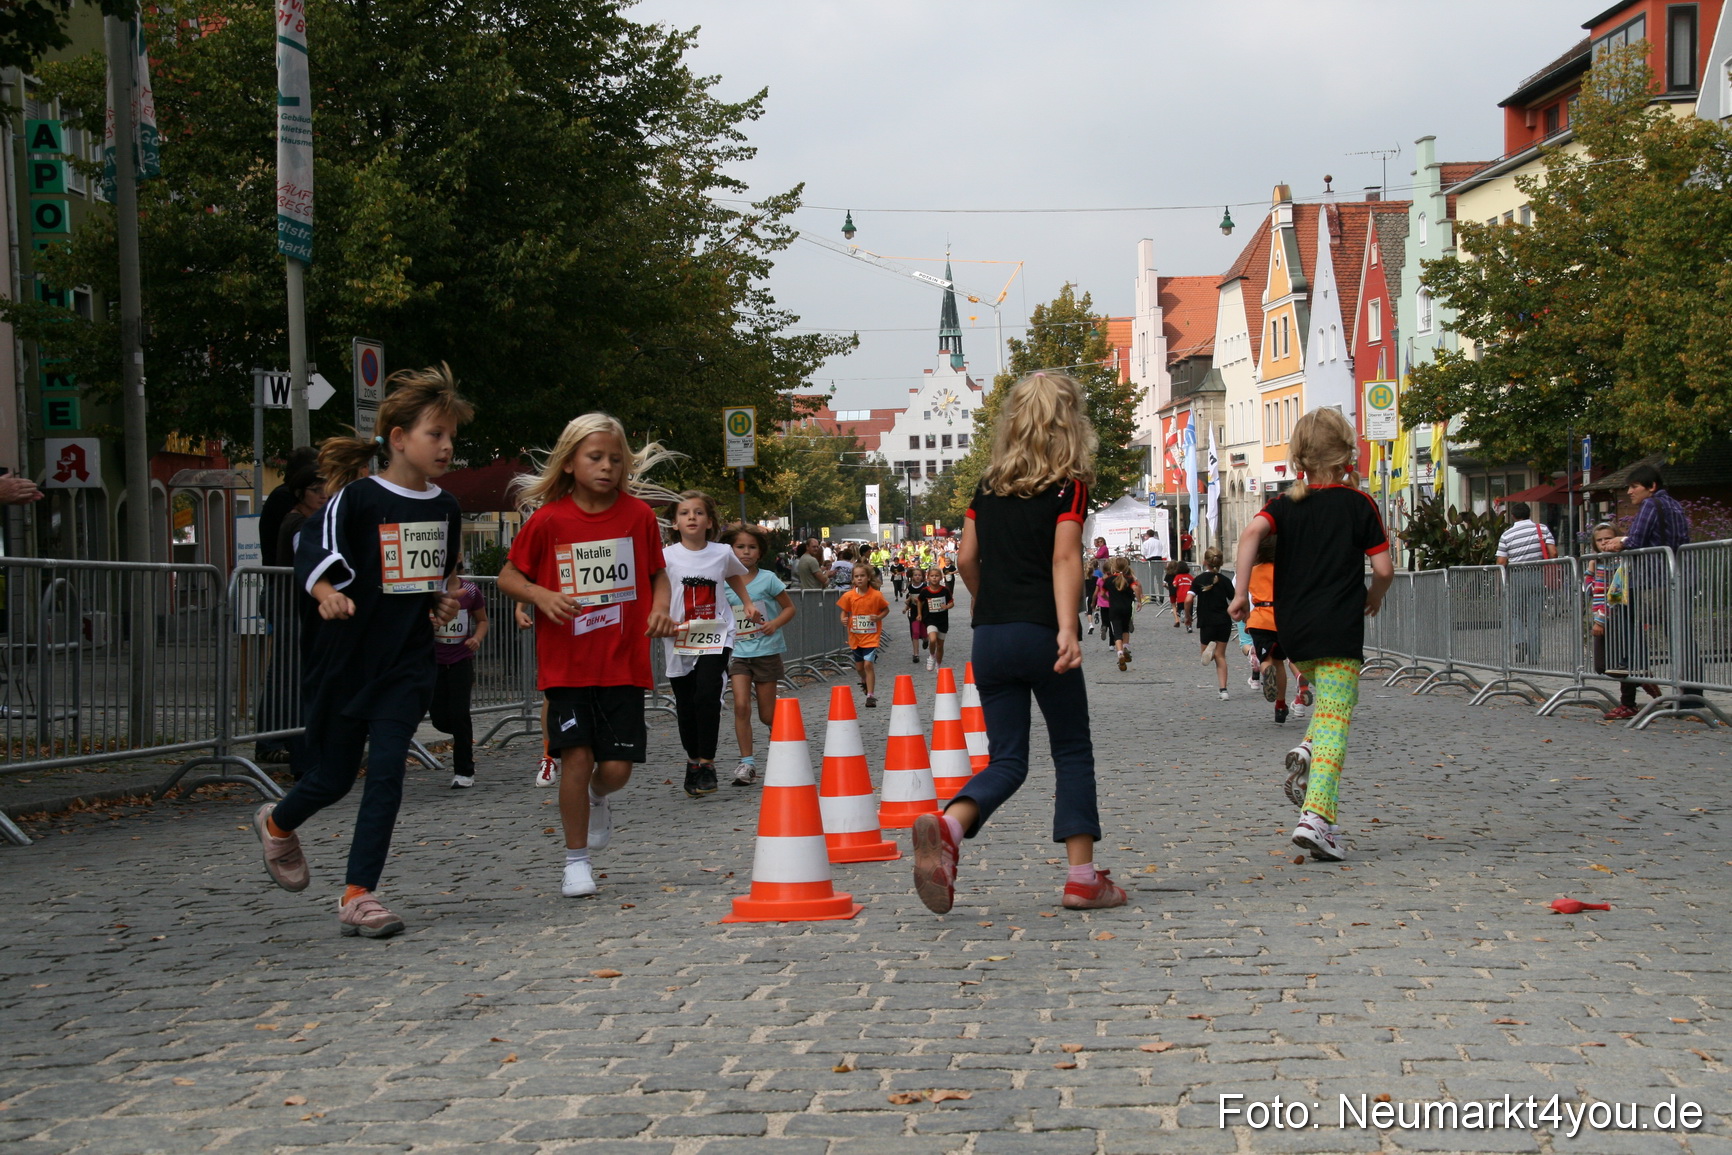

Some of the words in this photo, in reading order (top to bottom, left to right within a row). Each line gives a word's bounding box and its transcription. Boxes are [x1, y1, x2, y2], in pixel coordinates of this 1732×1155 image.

[32, 123, 73, 427] APOHKE
[364, 388, 377, 399] ZONE
[404, 526, 445, 542] Franziska
[385, 550, 397, 561] K3
[407, 548, 446, 570] 7062
[576, 545, 612, 560] Natalie
[560, 567, 571, 579] K3
[579, 562, 629, 586] 7040
[436, 622, 464, 633] 140
[586, 614, 607, 628] DEHN
[736, 614, 766, 630] 72
[690, 632, 722, 644] 7258
